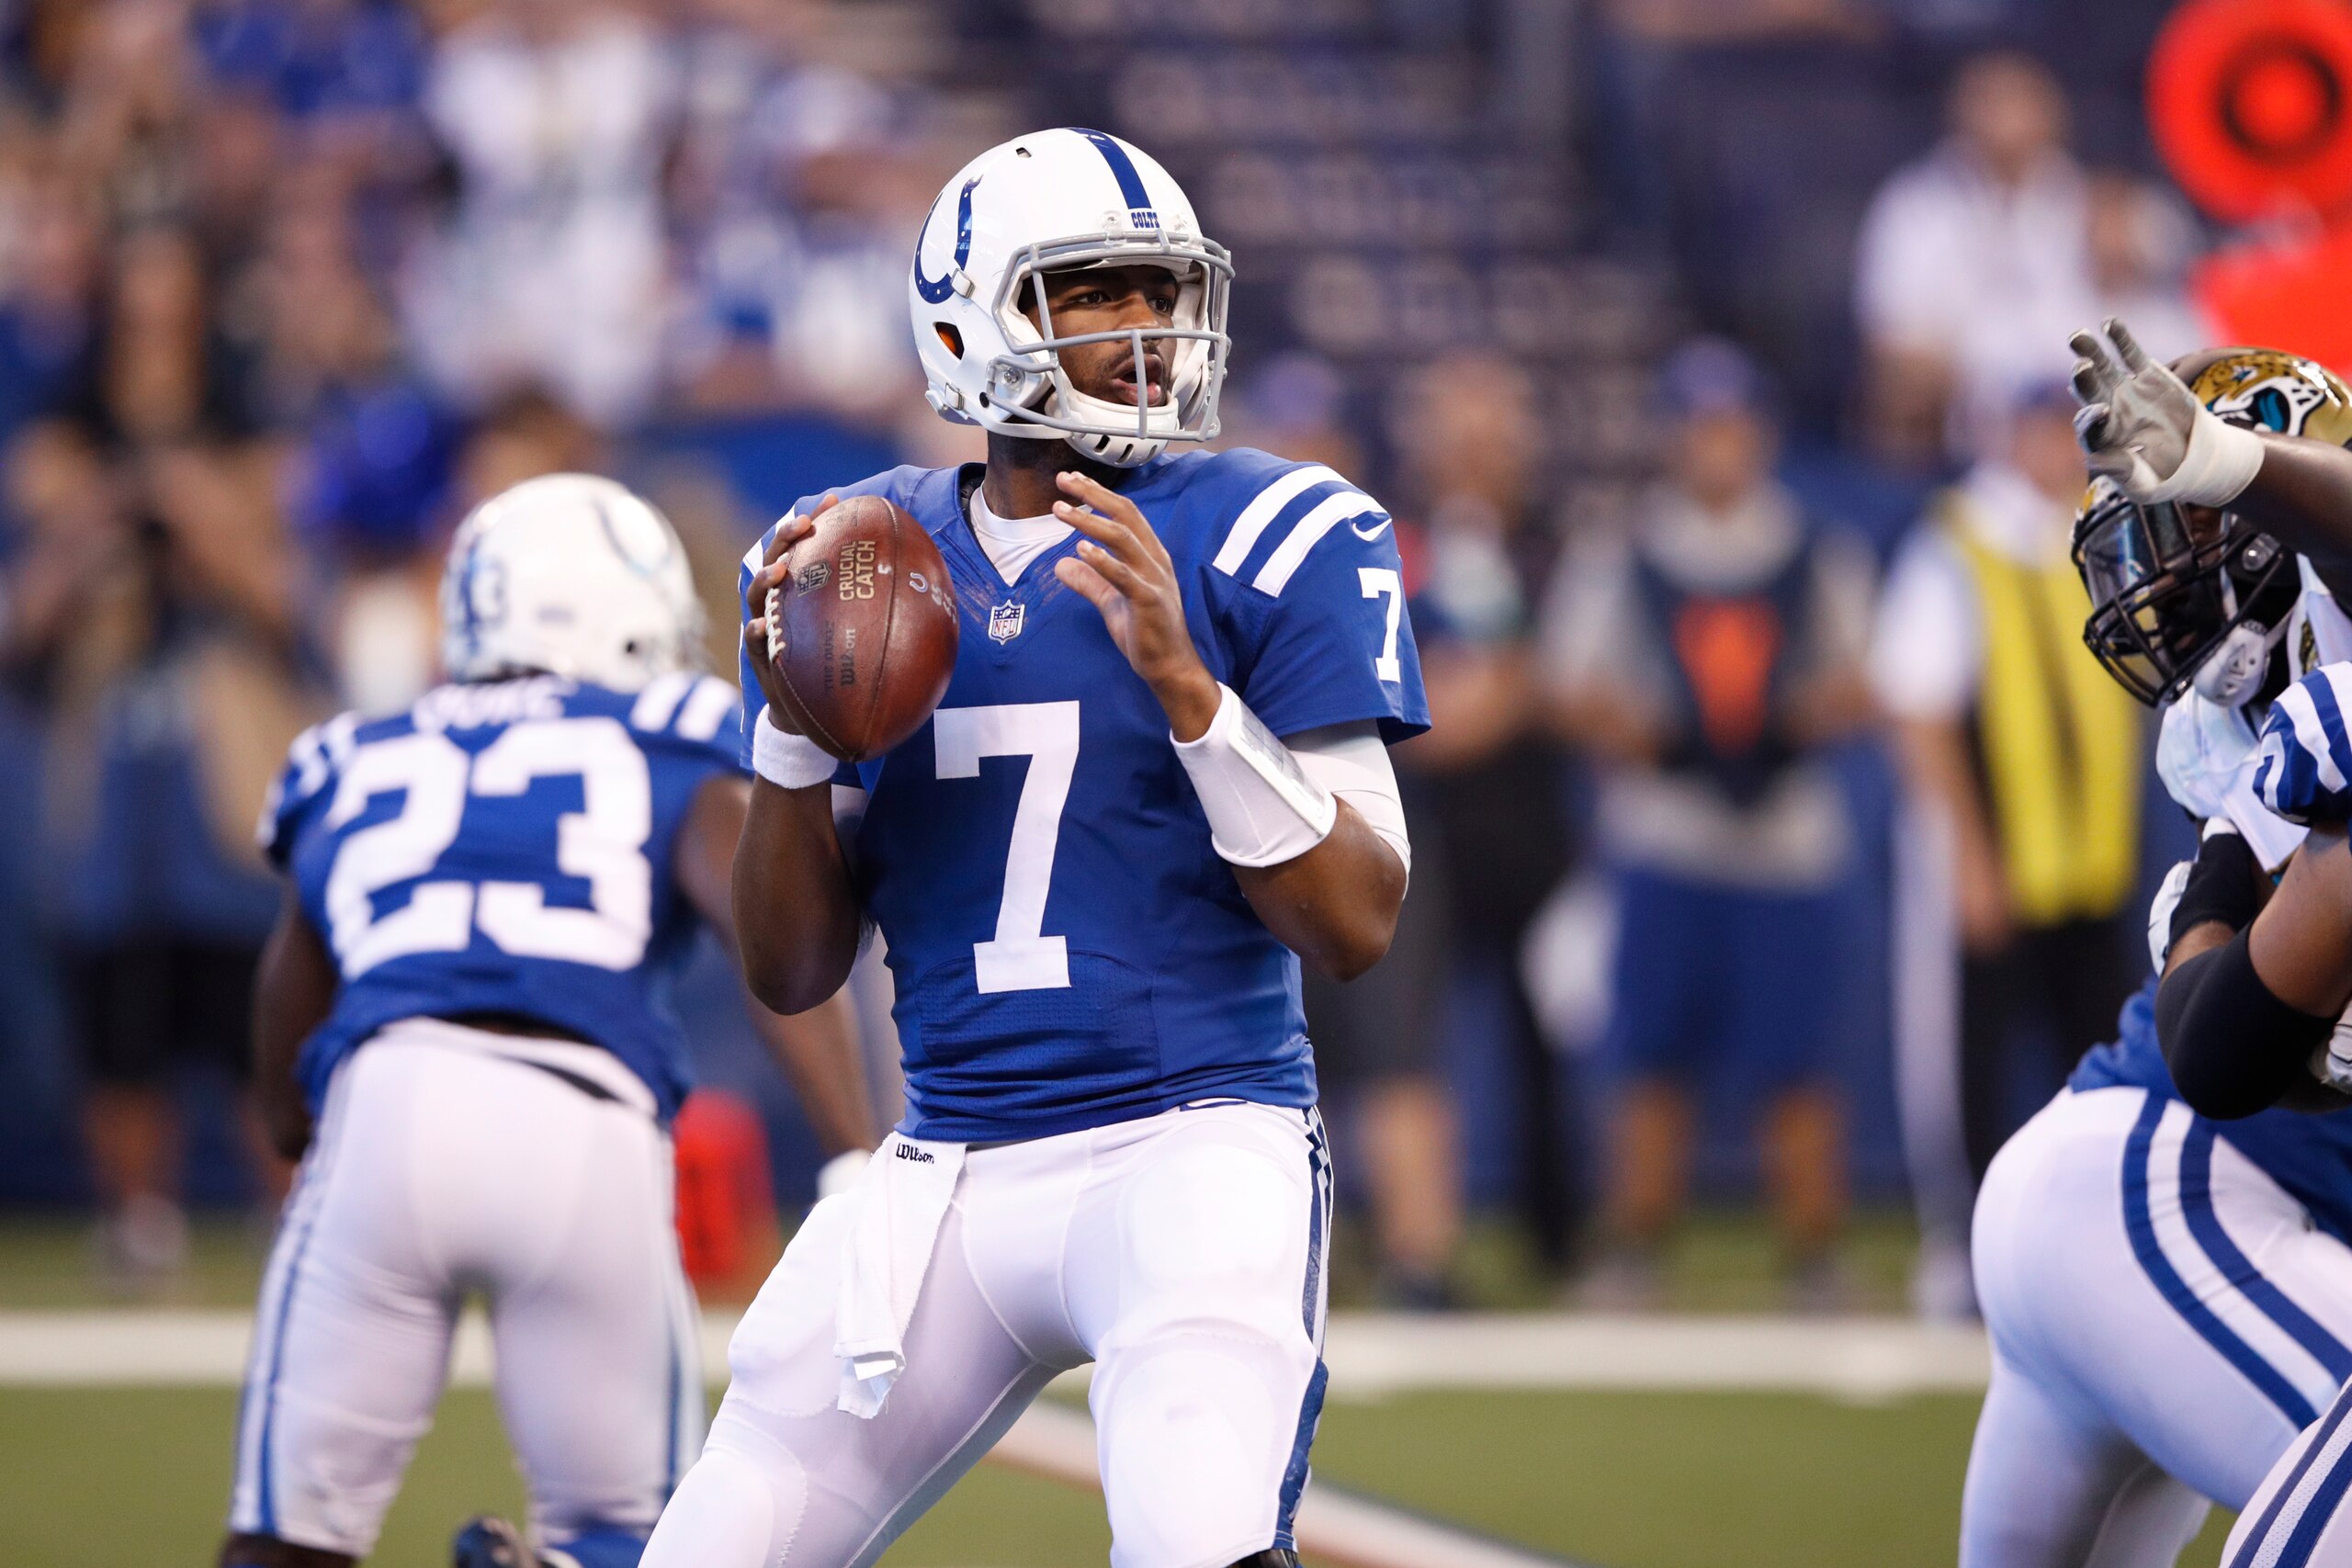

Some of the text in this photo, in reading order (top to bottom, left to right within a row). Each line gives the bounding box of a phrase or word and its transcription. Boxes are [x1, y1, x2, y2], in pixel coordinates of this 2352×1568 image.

[1131, 211, 1160, 229] COLTS
[810, 563, 826, 589] NFL
[840, 541, 856, 601] CRUCIAL
[855, 540, 876, 600] CATCH
[994, 620, 1015, 636] NFL
[1357, 567, 1401, 683] 7
[324, 716, 651, 981] 23
[933, 700, 1080, 994] 7
[896, 1142, 934, 1164] Wilson
